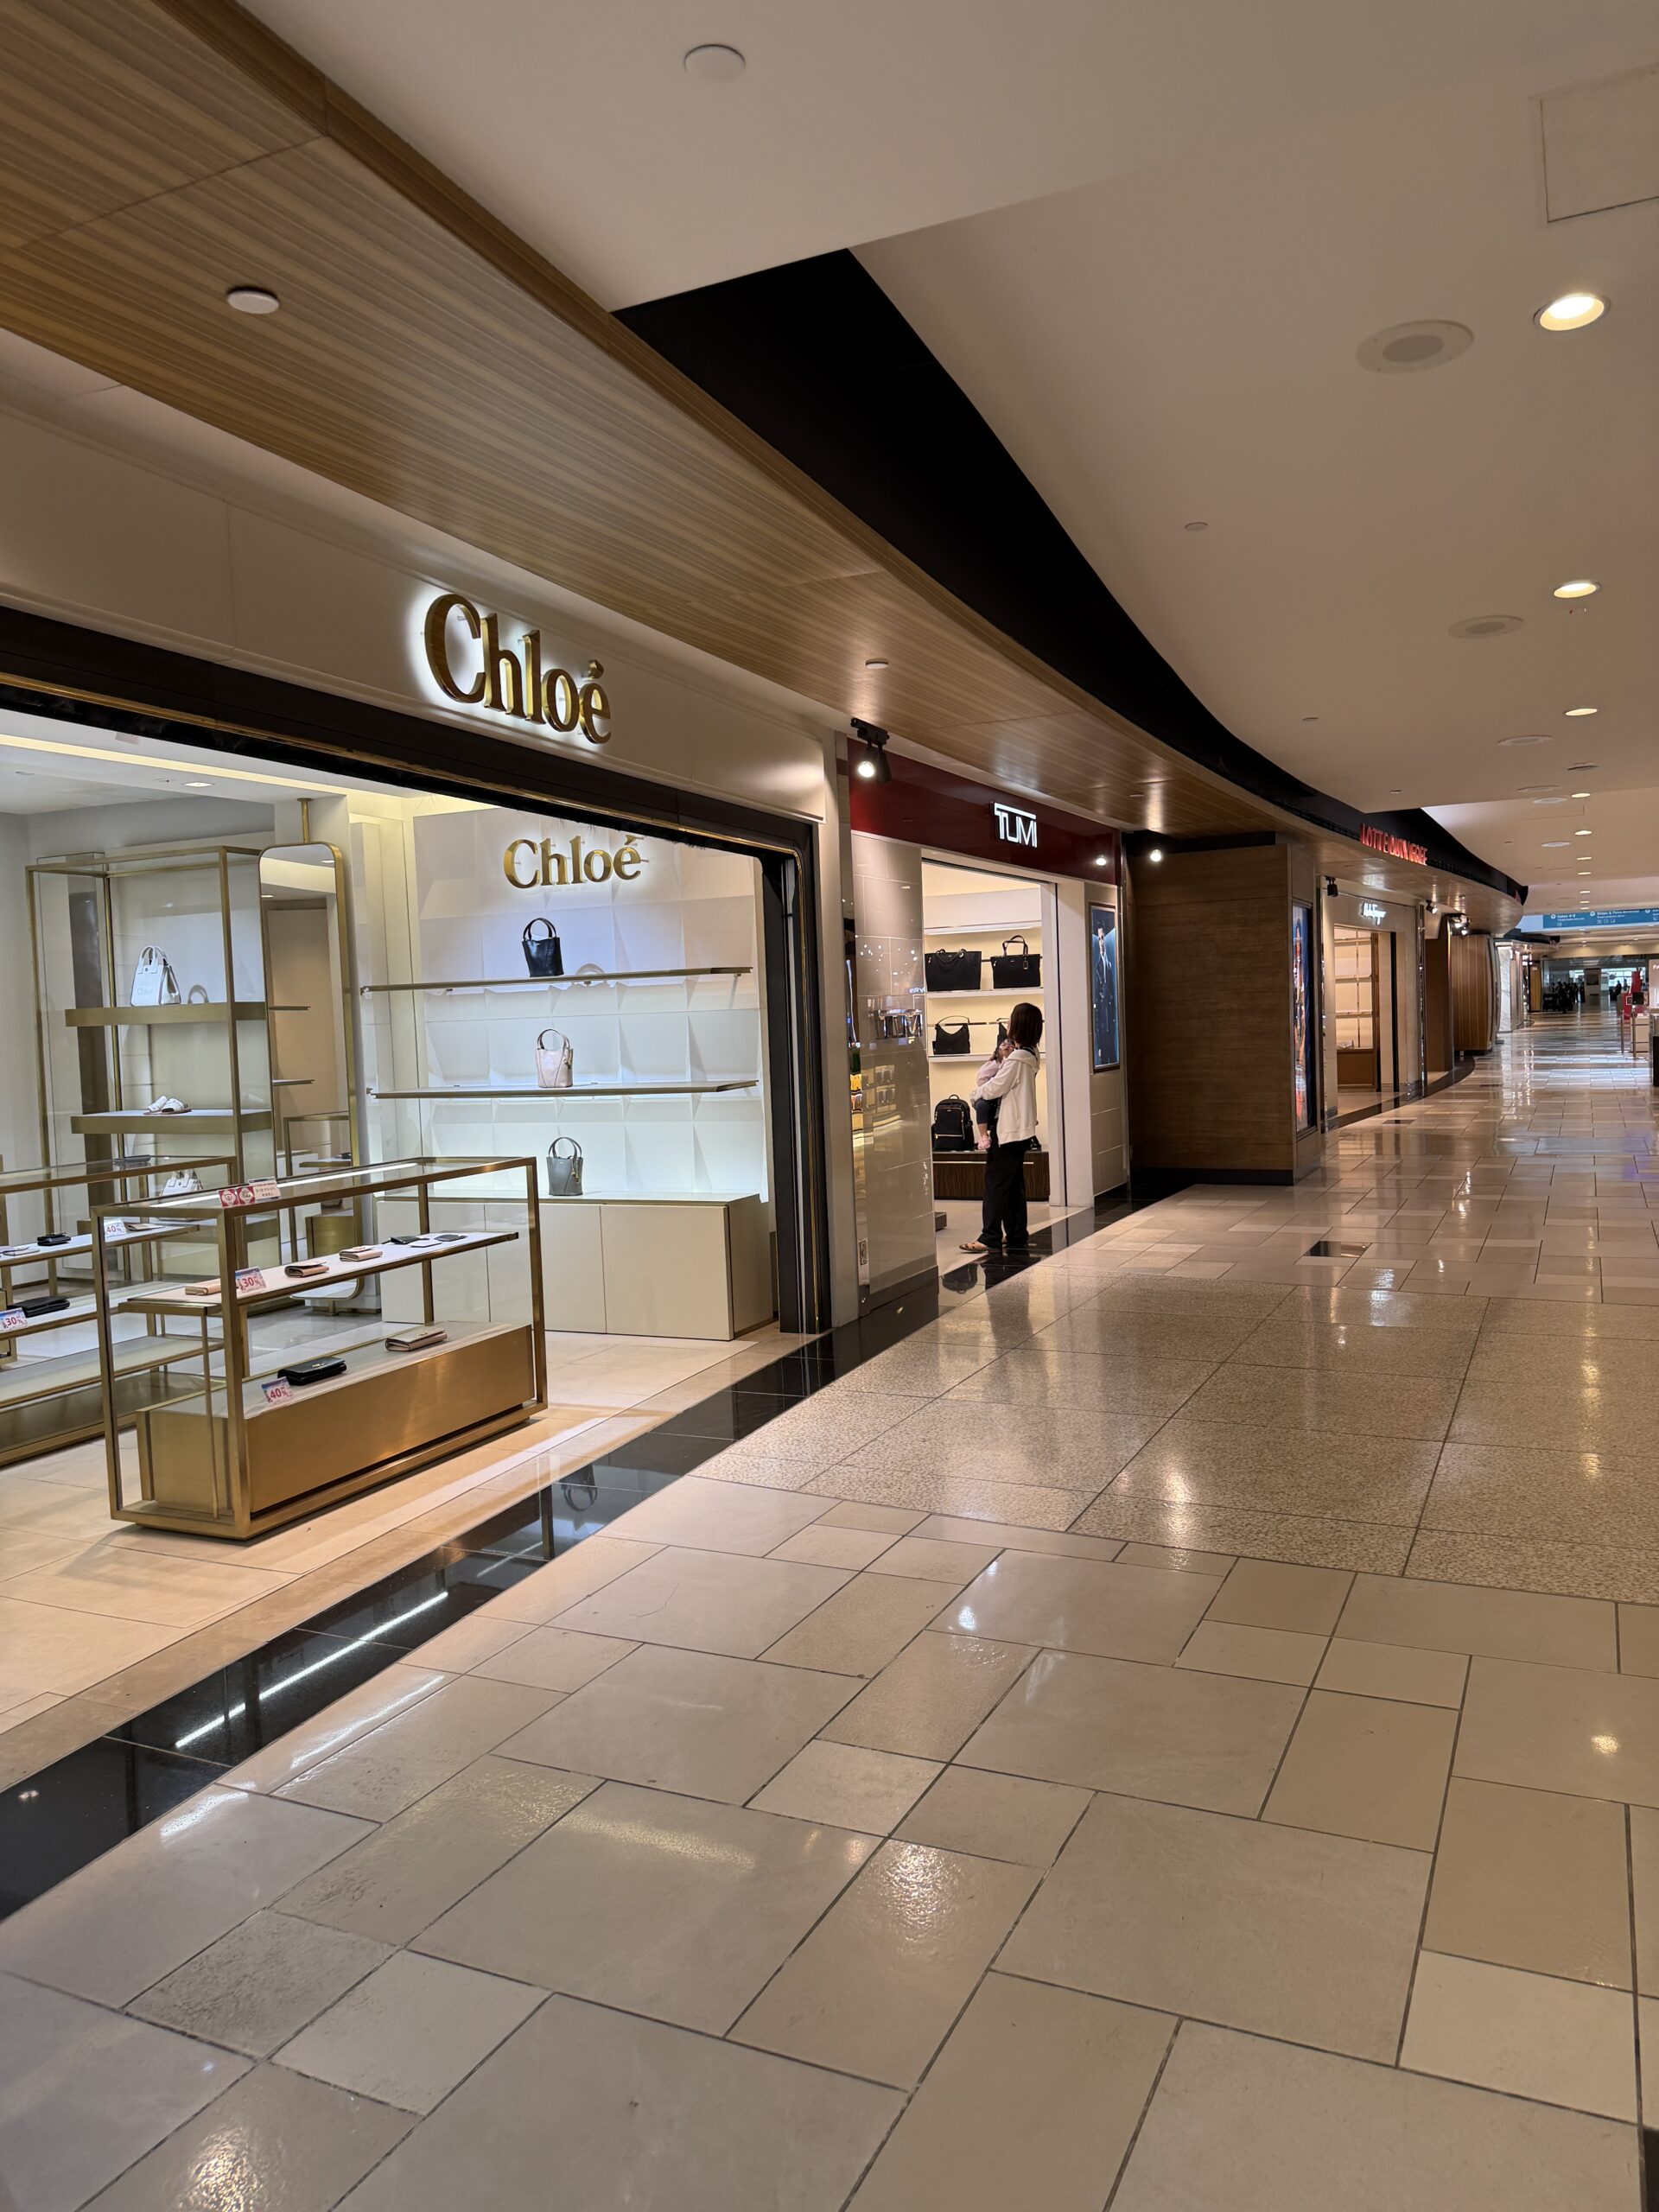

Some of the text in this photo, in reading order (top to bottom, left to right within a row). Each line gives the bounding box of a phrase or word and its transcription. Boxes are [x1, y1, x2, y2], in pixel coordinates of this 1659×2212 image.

[423, 593, 612, 745] Chloé
[994, 802, 1038, 849] TUMI
[1360, 823, 1388, 854] LOTTE
[503, 834, 642, 889] Chloé
